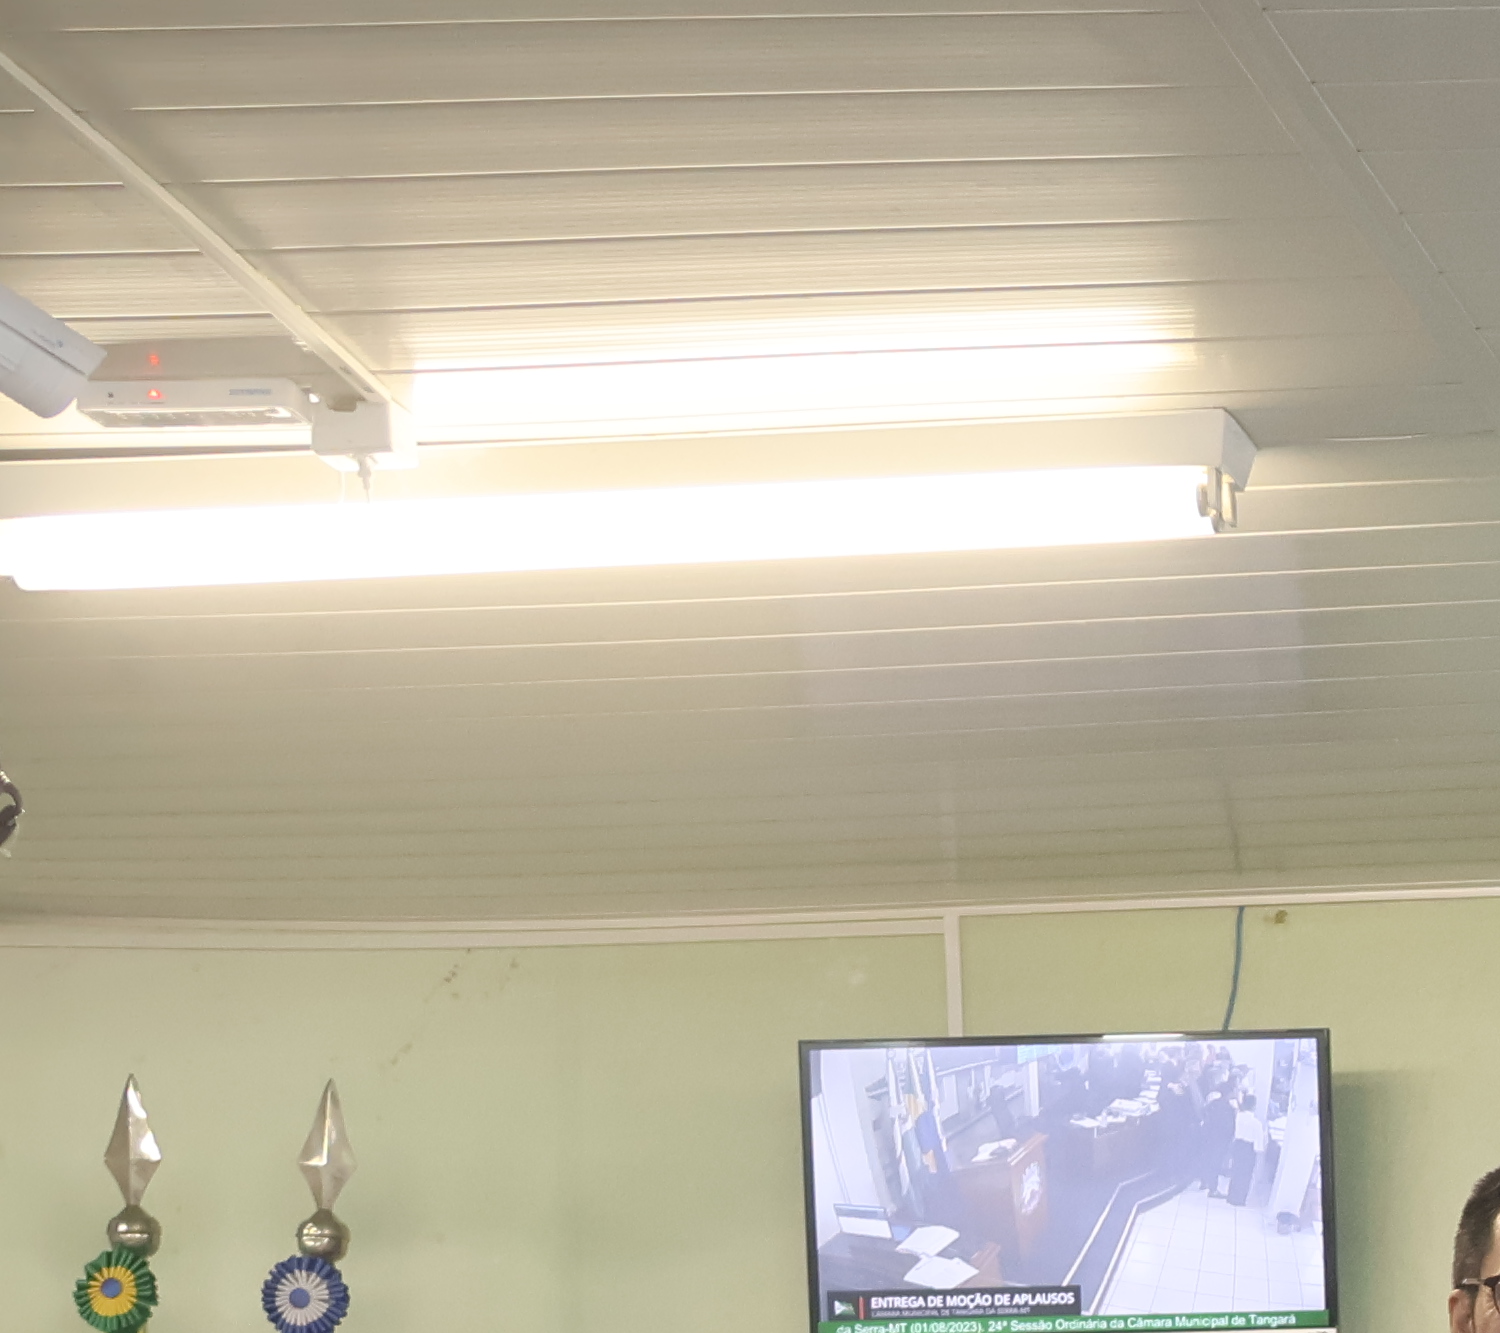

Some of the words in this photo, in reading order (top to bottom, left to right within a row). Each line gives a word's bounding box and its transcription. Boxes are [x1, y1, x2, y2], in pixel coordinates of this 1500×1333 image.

[870, 1296, 926, 1309] ENTREGA
[927, 1296, 944, 1307] DE
[946, 1293, 992, 1309] MOÇÃO
[994, 1295, 1010, 1305] DE
[1012, 1292, 1075, 1305] APLAUSOS
[1010, 1318, 1052, 1332] Sessão
[1055, 1317, 1108, 1330] Ordinária
[1109, 1317, 1125, 1329] da
[1127, 1315, 1173, 1328] Câmara
[1175, 1315, 1229, 1329] Municipal
[1231, 1313, 1246, 1325] de
[1249, 1313, 1296, 1328] Tangará
